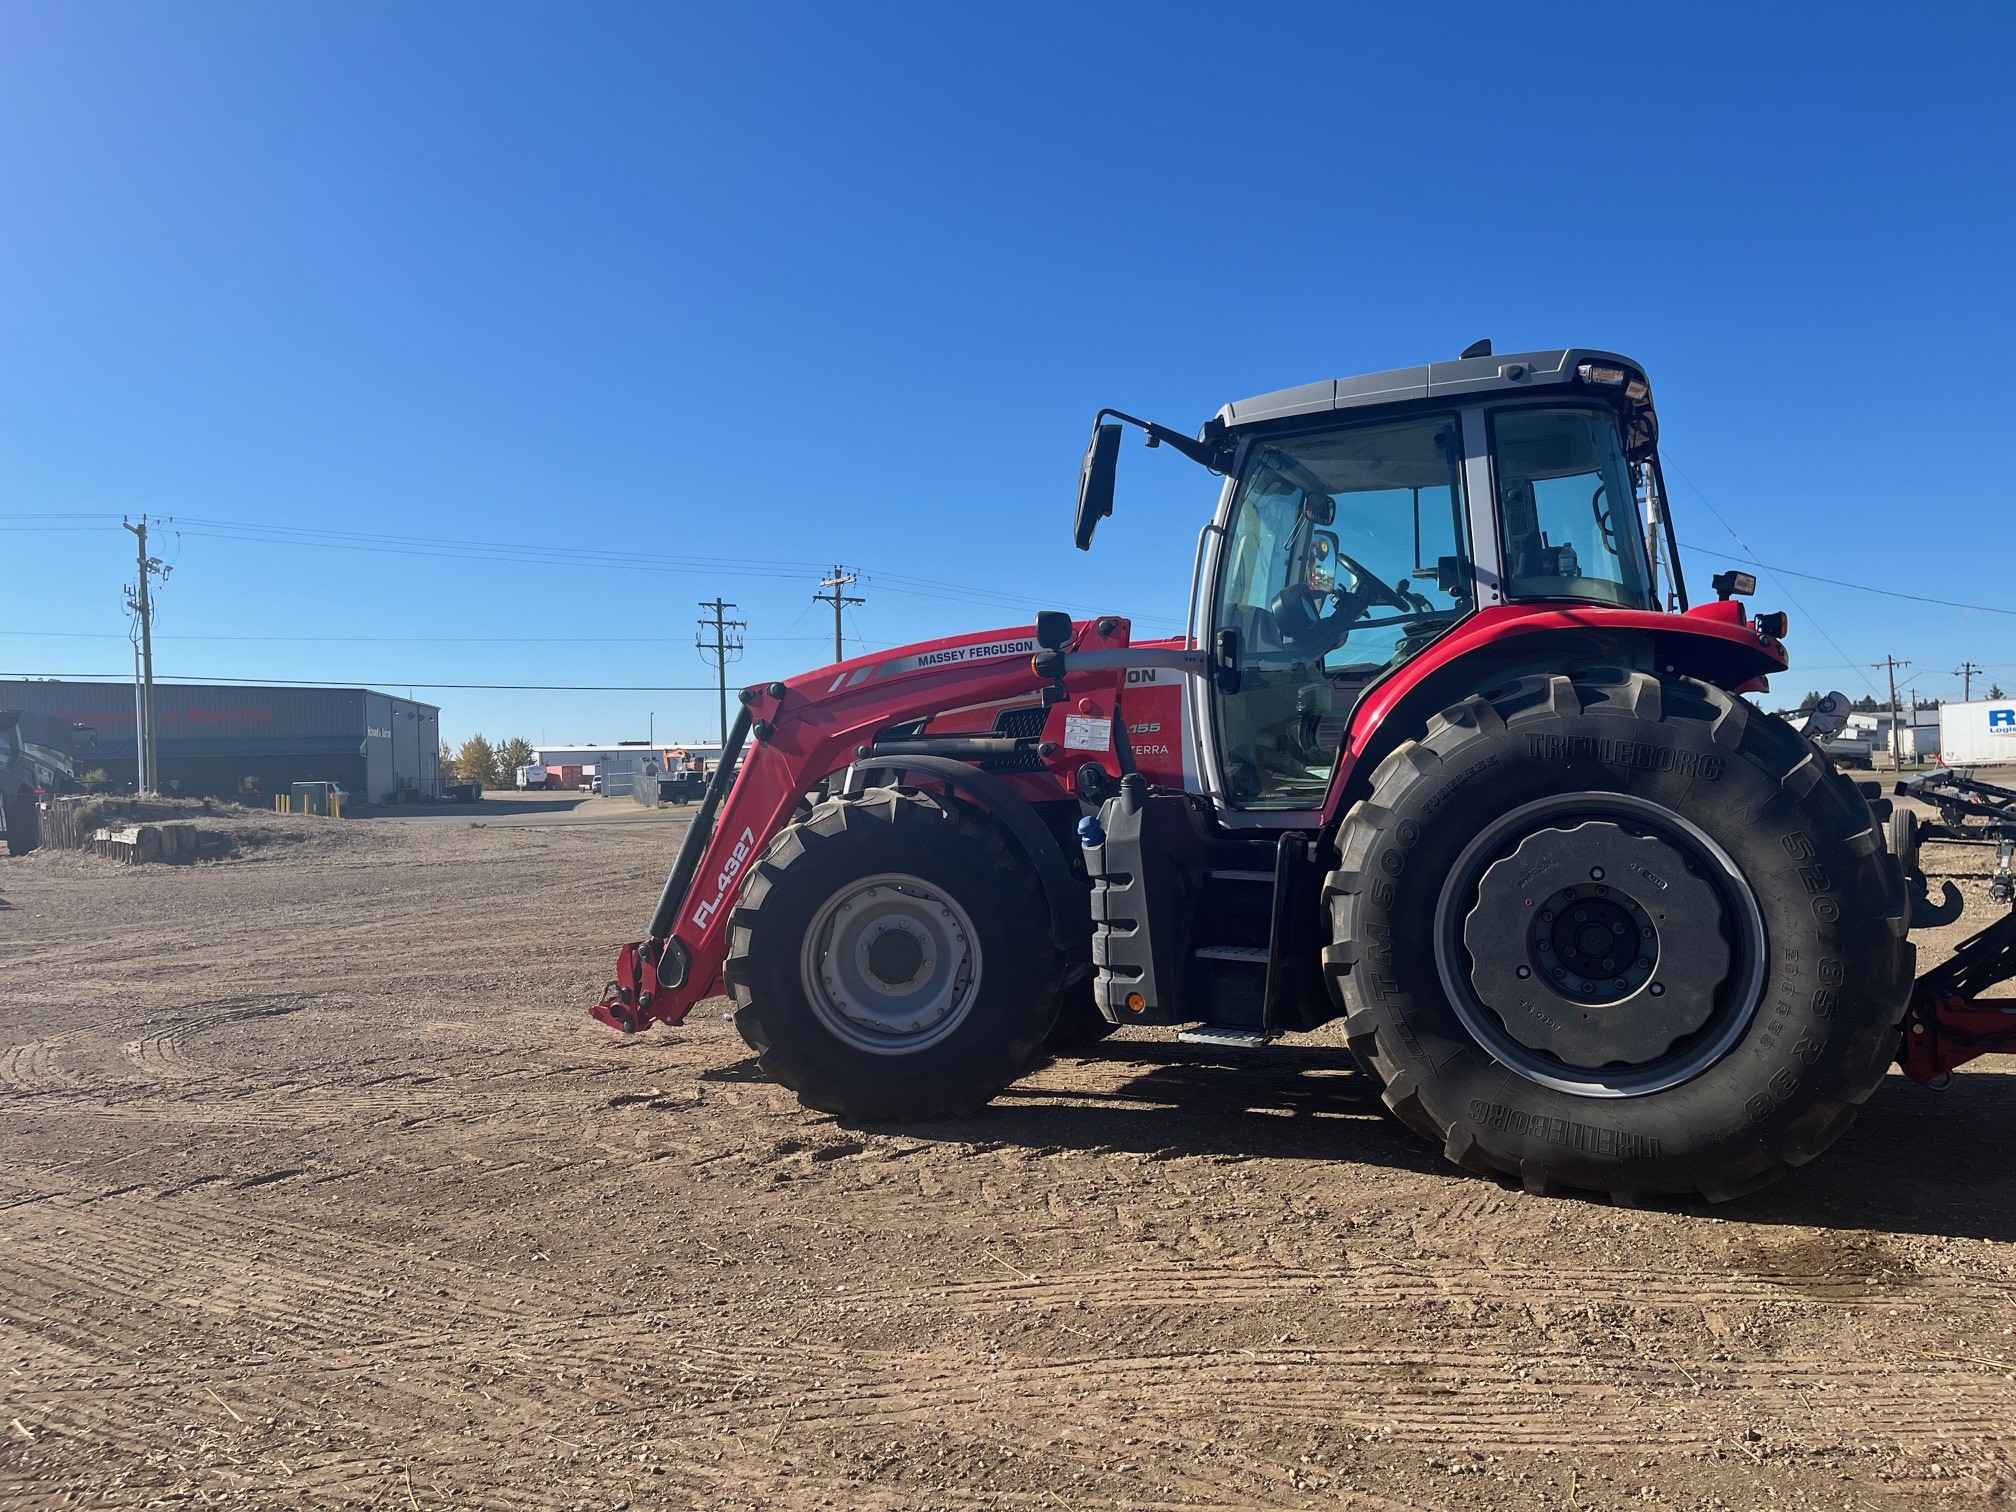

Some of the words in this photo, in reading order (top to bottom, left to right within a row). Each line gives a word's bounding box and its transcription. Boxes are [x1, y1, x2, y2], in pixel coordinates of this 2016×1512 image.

[918, 649, 966, 667] MASSEY
[969, 641, 1033, 659] FERGUSON
[692, 826, 755, 930] FL.4327
[1466, 1098, 1662, 1160] TRELLEBORG
